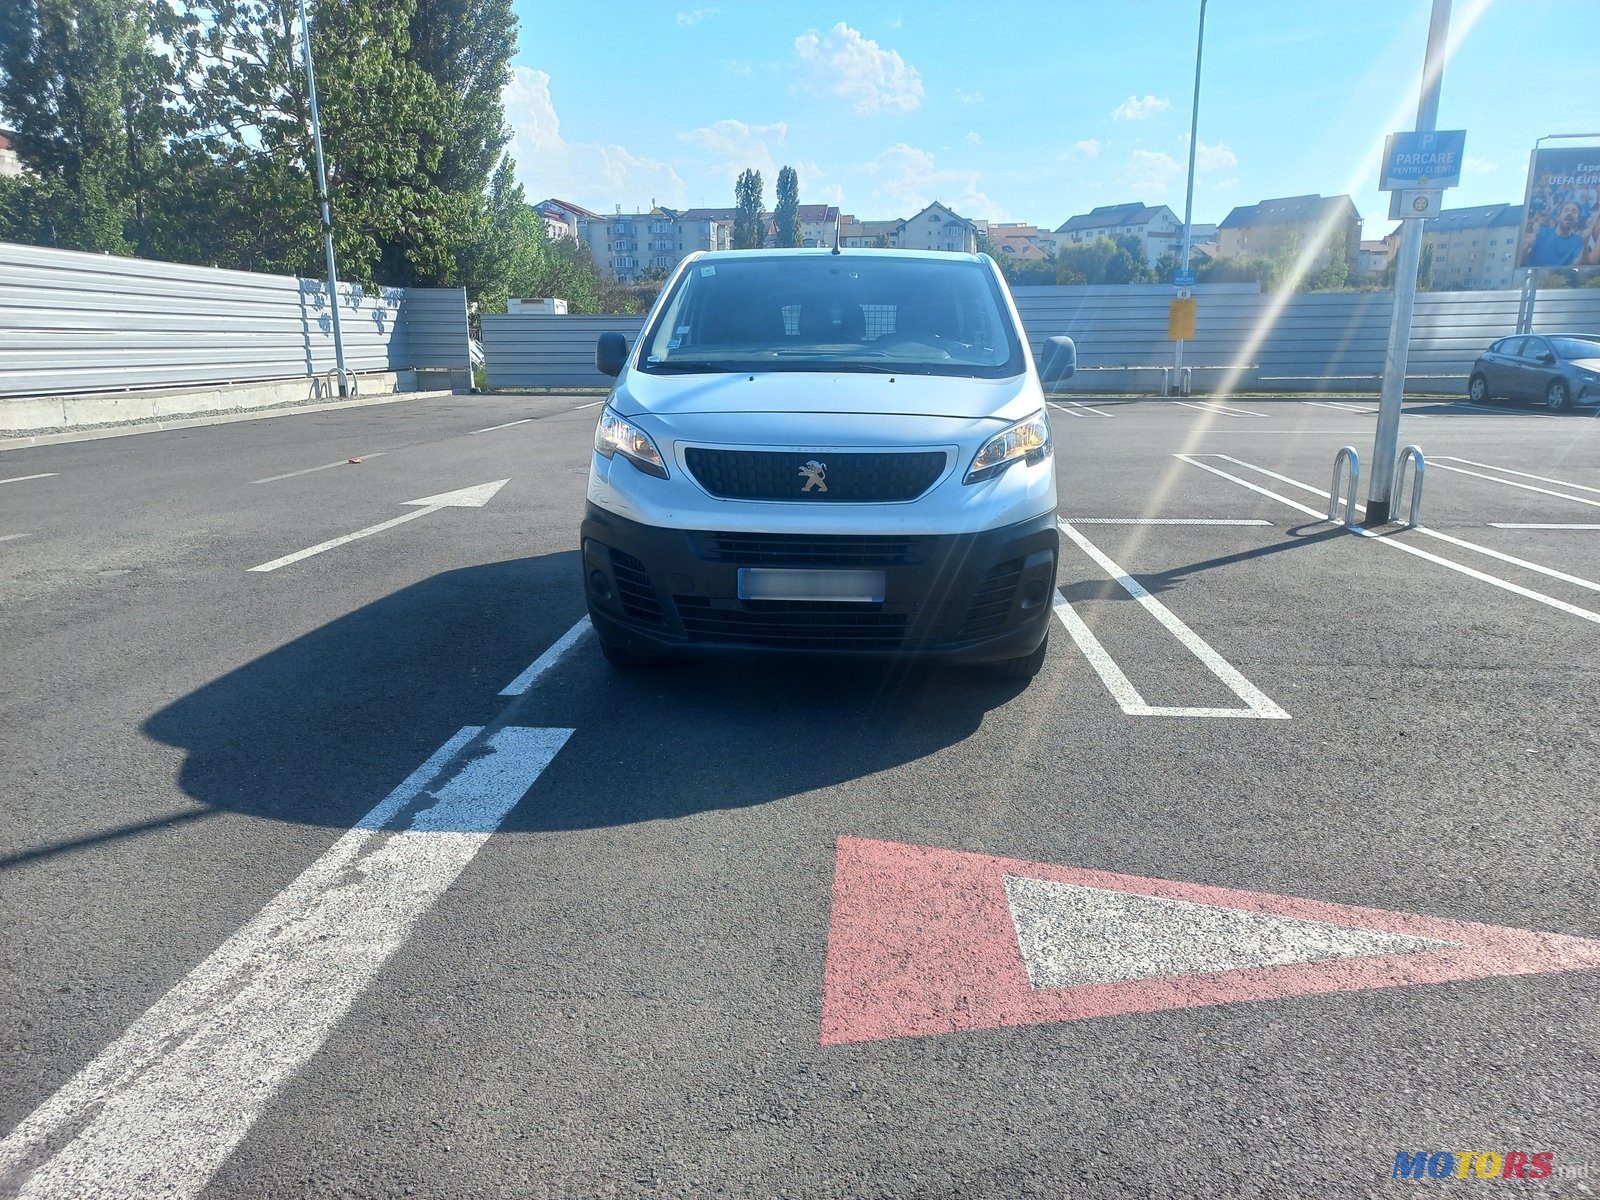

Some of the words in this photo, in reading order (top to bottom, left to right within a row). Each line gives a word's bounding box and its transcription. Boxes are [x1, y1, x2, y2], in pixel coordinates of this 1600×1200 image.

[1423, 134, 1434, 149] P
[1396, 152, 1456, 165] PARCARE
[1392, 166, 1423, 175] PENTRU
[1549, 176, 1575, 185] UEFA
[1576, 175, 1600, 184] EUR
